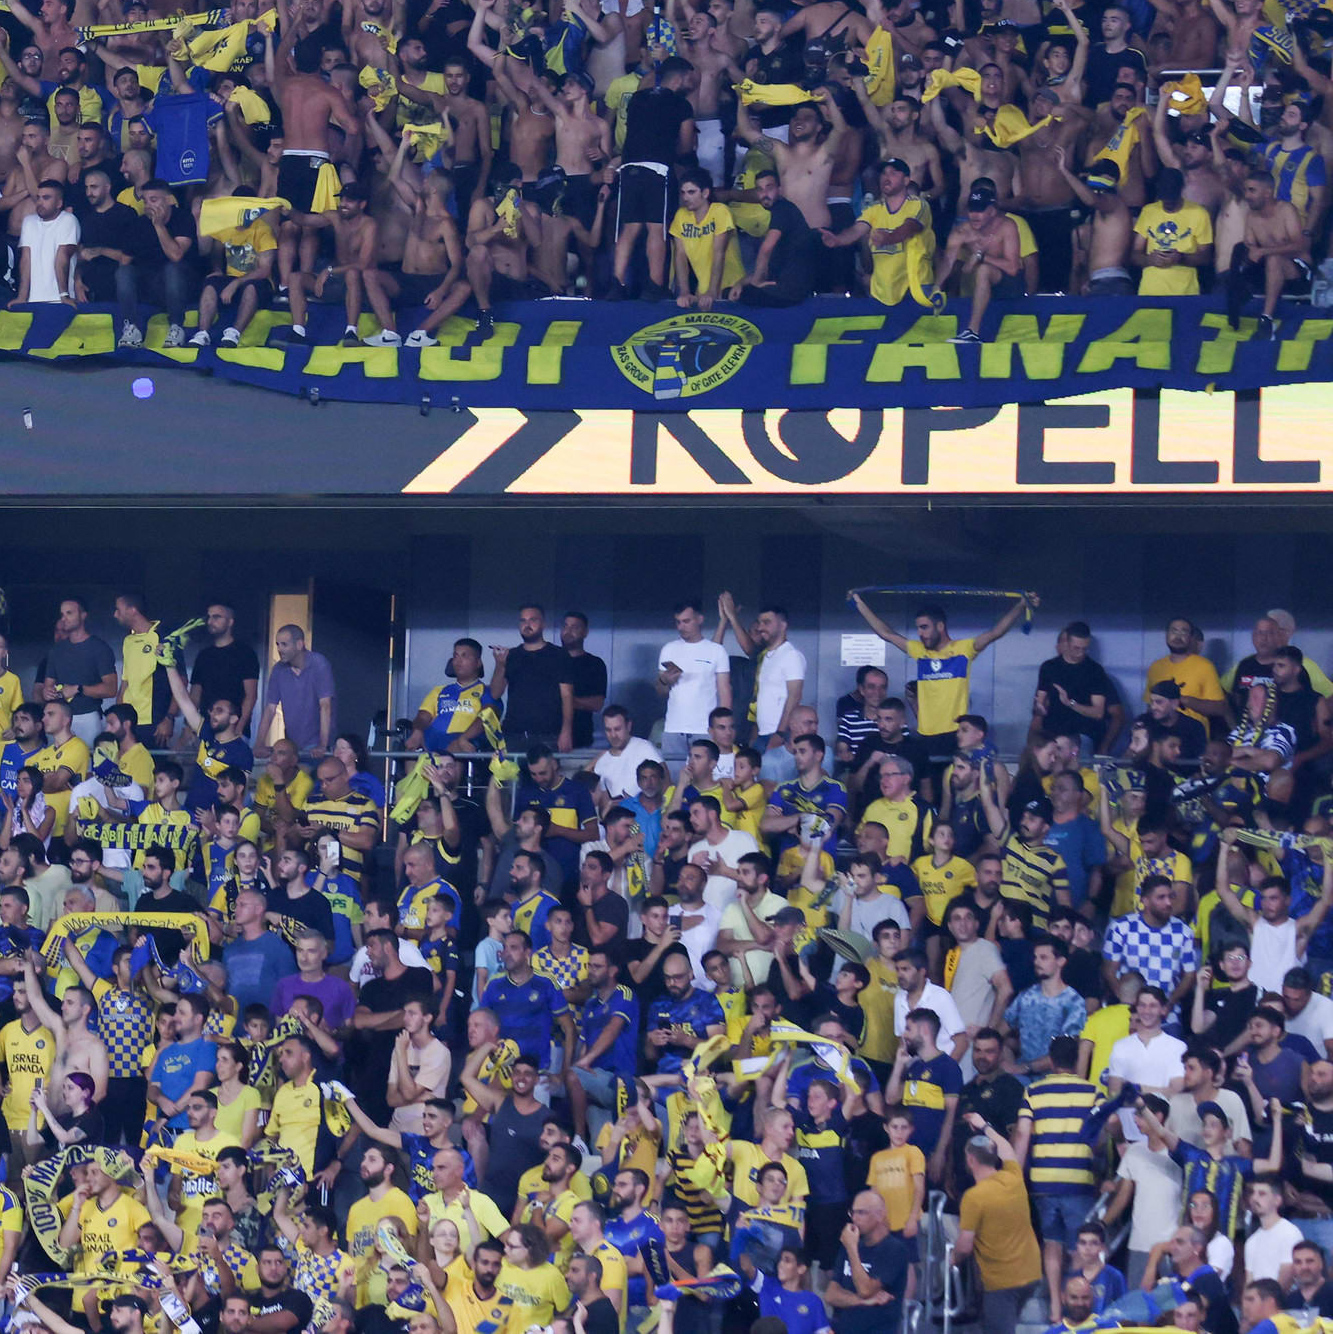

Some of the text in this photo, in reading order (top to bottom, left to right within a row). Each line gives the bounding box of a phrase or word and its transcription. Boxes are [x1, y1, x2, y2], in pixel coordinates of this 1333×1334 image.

[684, 314, 726, 327] MACCABI
[125, 825, 184, 846] TEL AVIV
[13, 1055, 41, 1063] ISRAEL
[10, 1064, 44, 1074] CANADA
